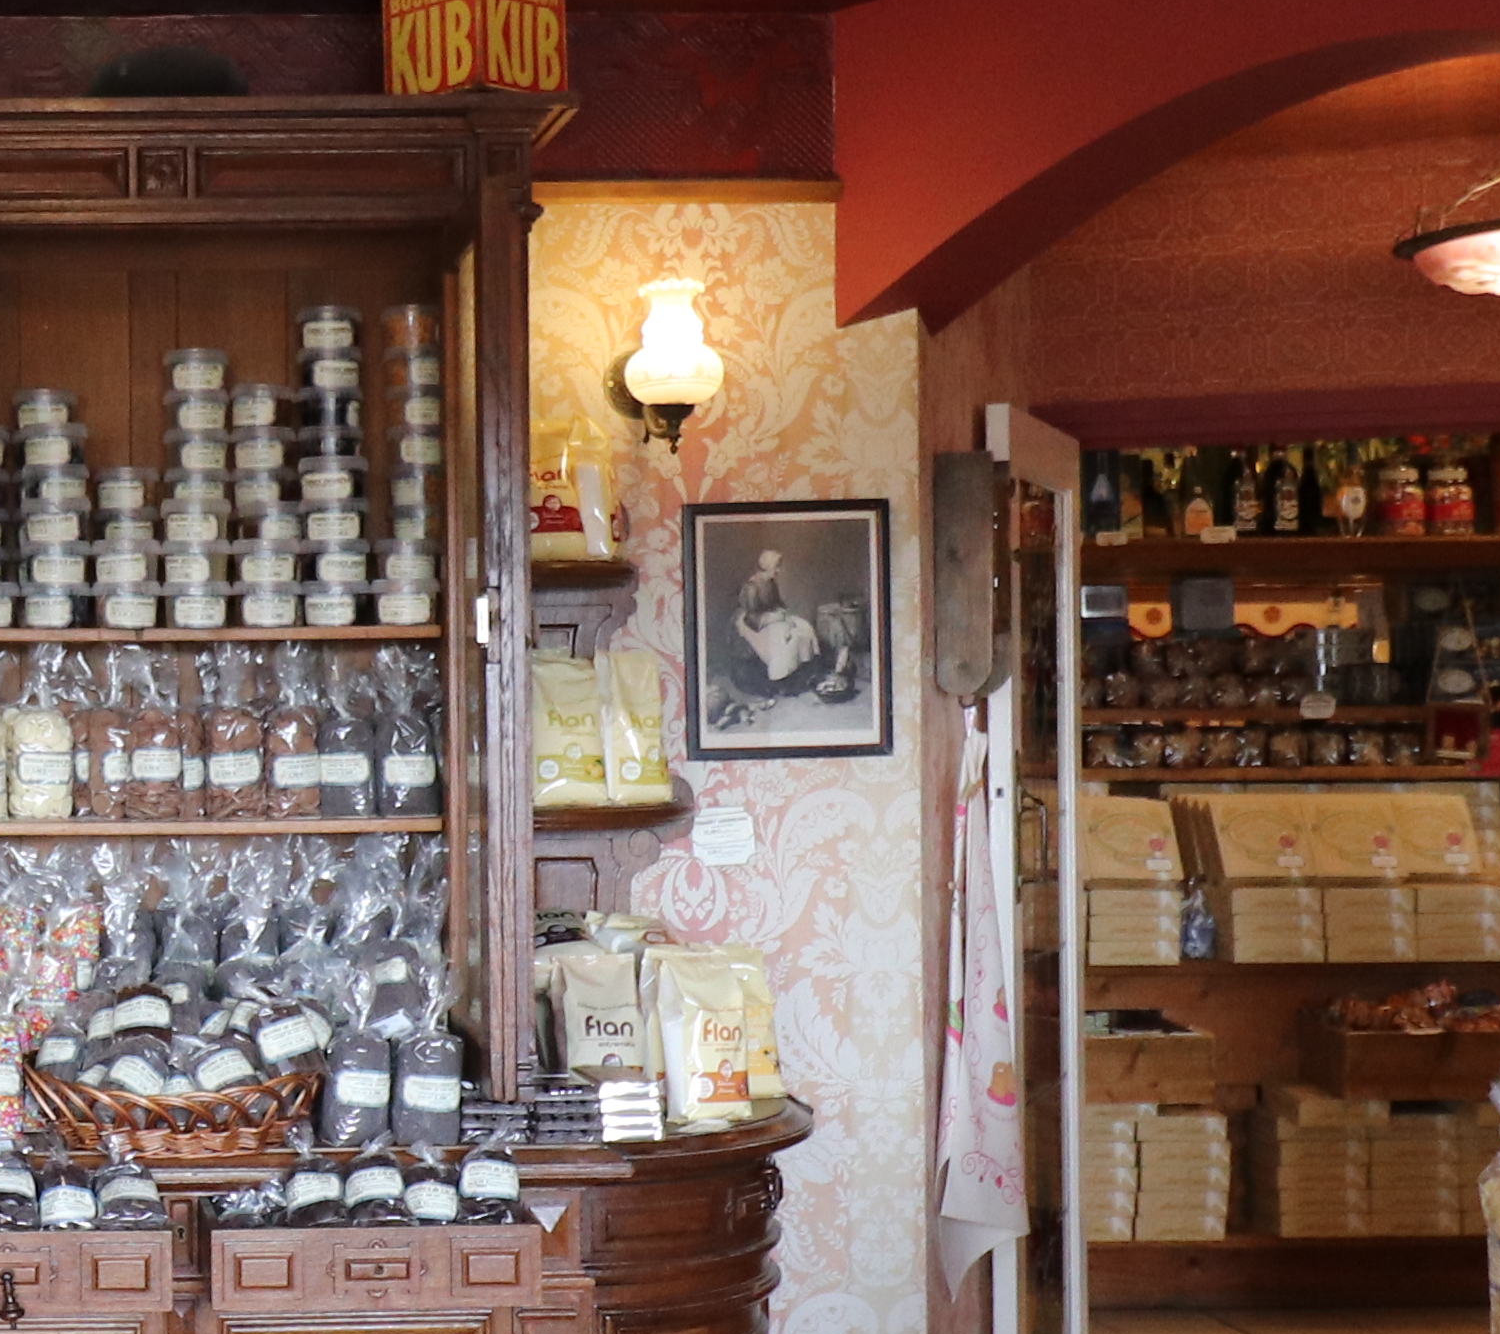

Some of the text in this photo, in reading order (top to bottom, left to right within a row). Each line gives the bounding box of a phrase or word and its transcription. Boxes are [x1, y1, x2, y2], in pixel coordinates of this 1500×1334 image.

[390, 0, 474, 95] KUB
[530, 461, 571, 484] lan
[585, 1015, 634, 1037] flan
[702, 1018, 742, 1042] flan
